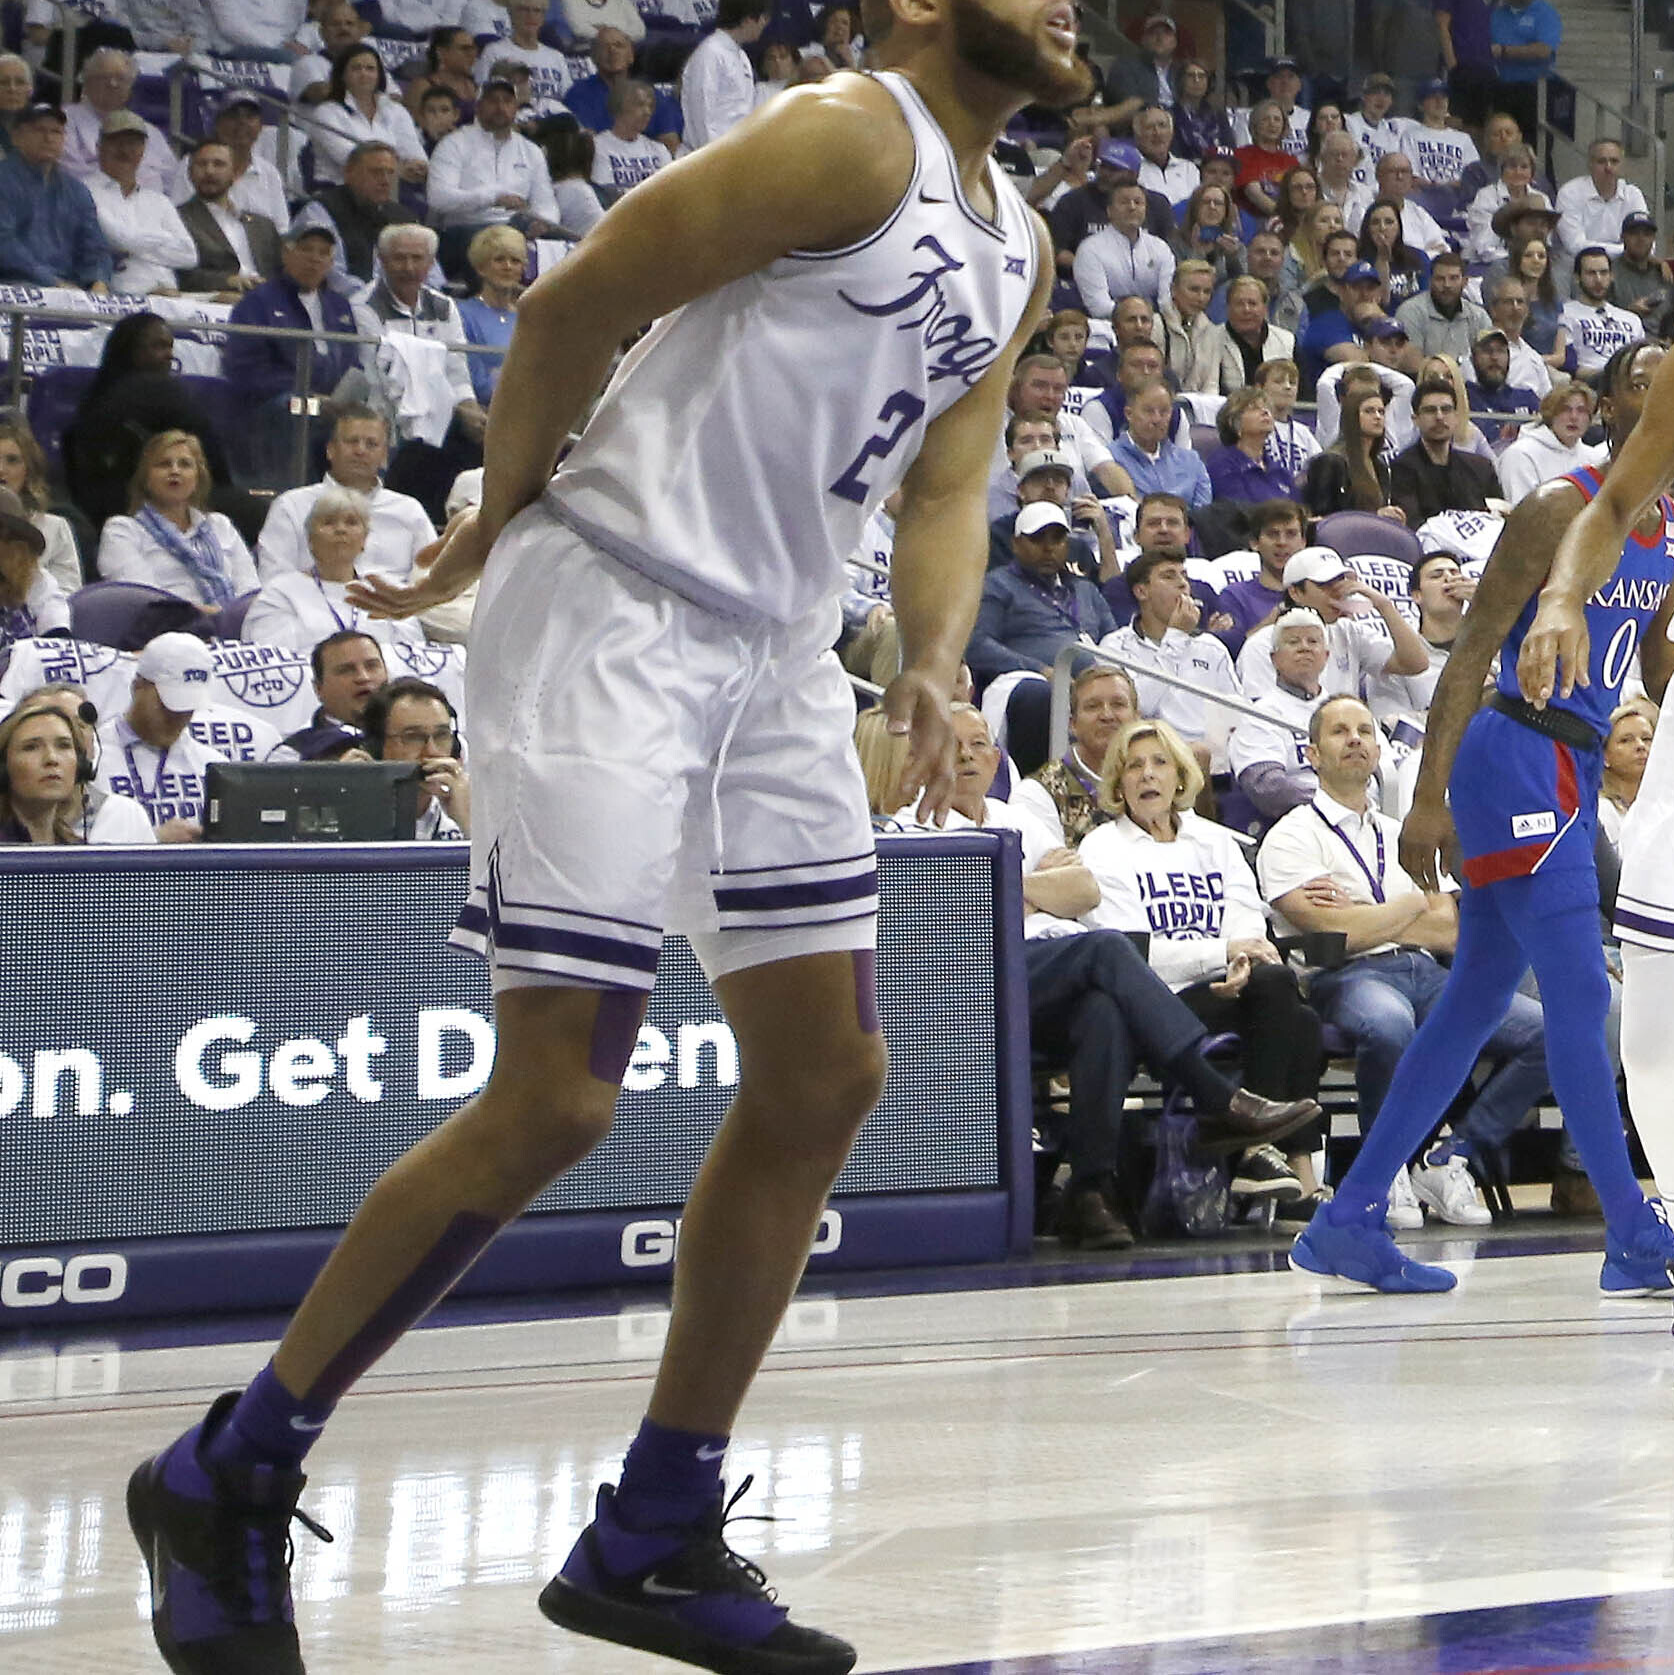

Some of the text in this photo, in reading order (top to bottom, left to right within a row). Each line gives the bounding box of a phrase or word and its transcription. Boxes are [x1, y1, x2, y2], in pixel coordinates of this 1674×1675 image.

[828, 390, 927, 505] 2
[1354, 560, 1410, 579] LEED
[1602, 618, 1638, 690] 0
[249, 679, 284, 695] TCU
[188, 721, 254, 744] EED
[110, 774, 205, 799] BLEE
[175, 1010, 390, 1112] Get
